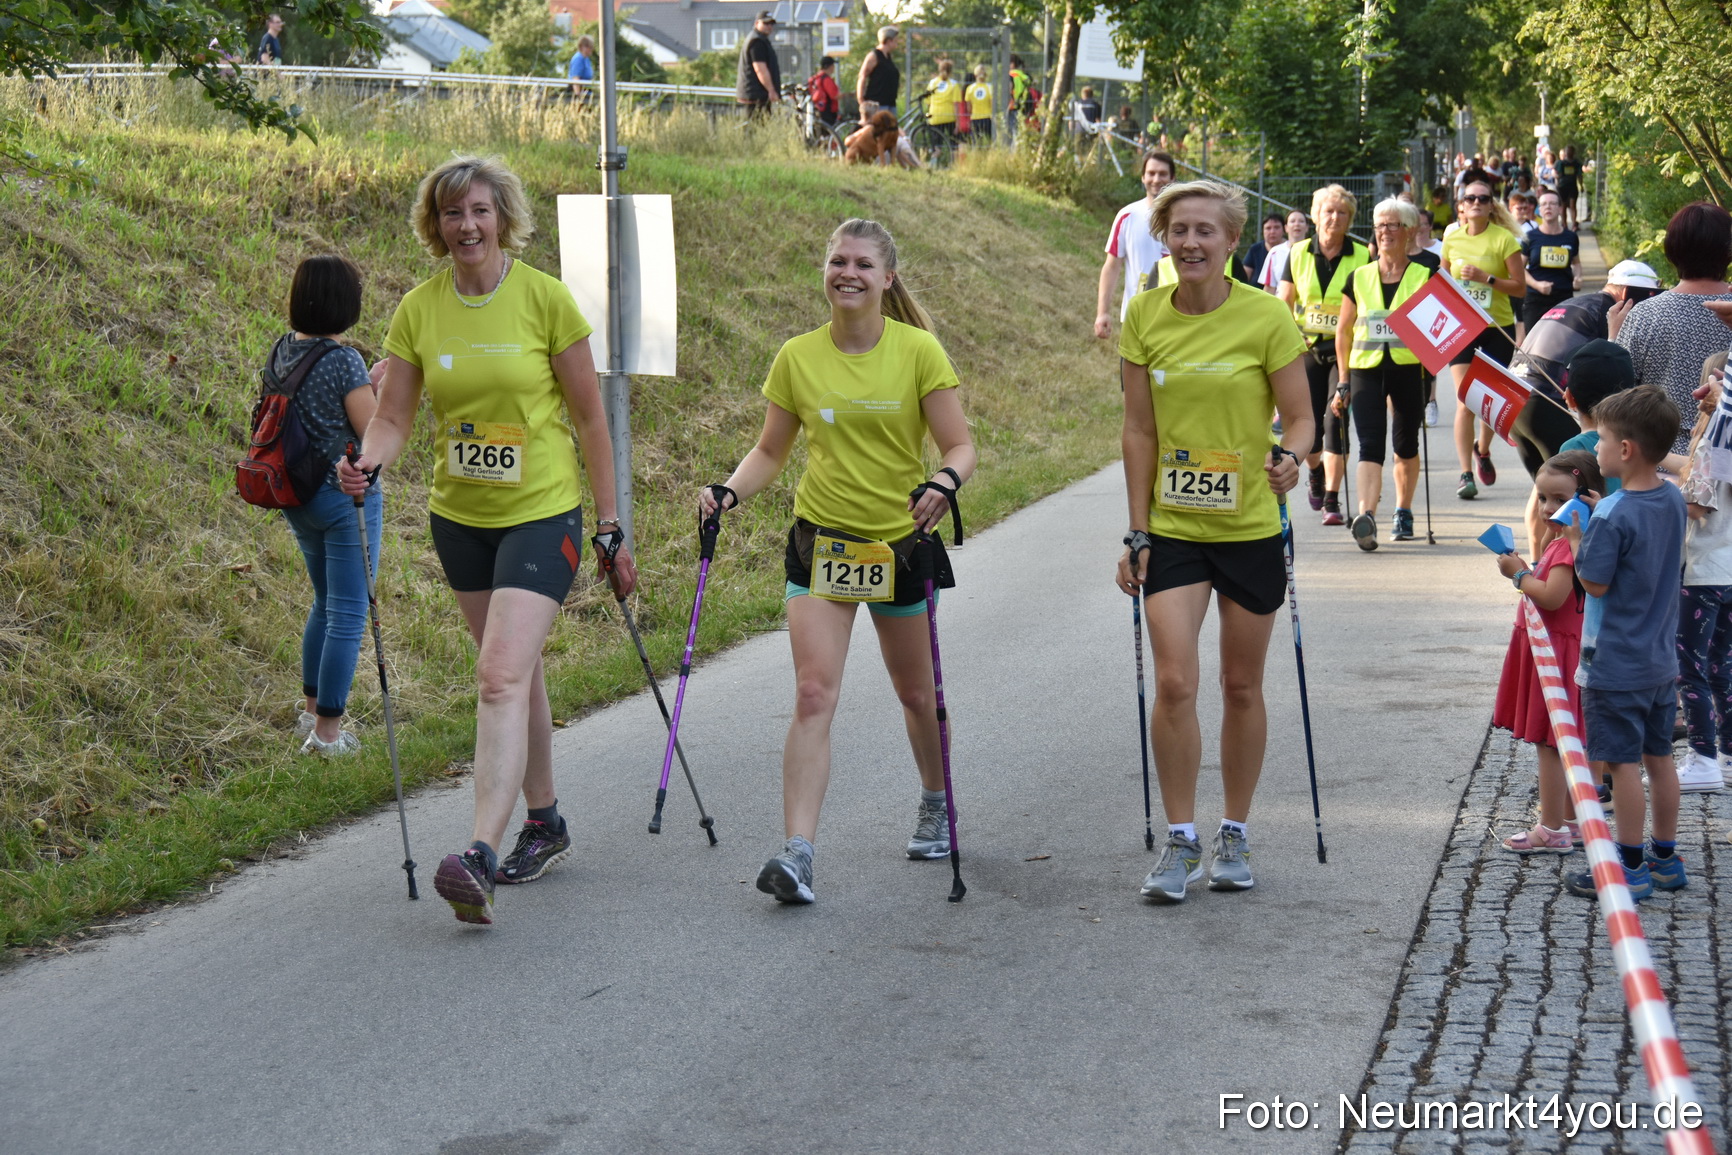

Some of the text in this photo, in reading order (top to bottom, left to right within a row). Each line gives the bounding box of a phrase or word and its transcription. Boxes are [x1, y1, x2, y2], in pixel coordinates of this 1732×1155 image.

[1545, 254, 1565, 262] 1430
[1309, 314, 1338, 326] 1516
[454, 442, 515, 469] 1266
[462, 466, 504, 476] Nagl Gerlinde
[1168, 469, 1230, 496] 1254
[1164, 492, 1205, 502] Kurzendorfer
[822, 560, 884, 586] 1218
[831, 584, 849, 592] Finke
